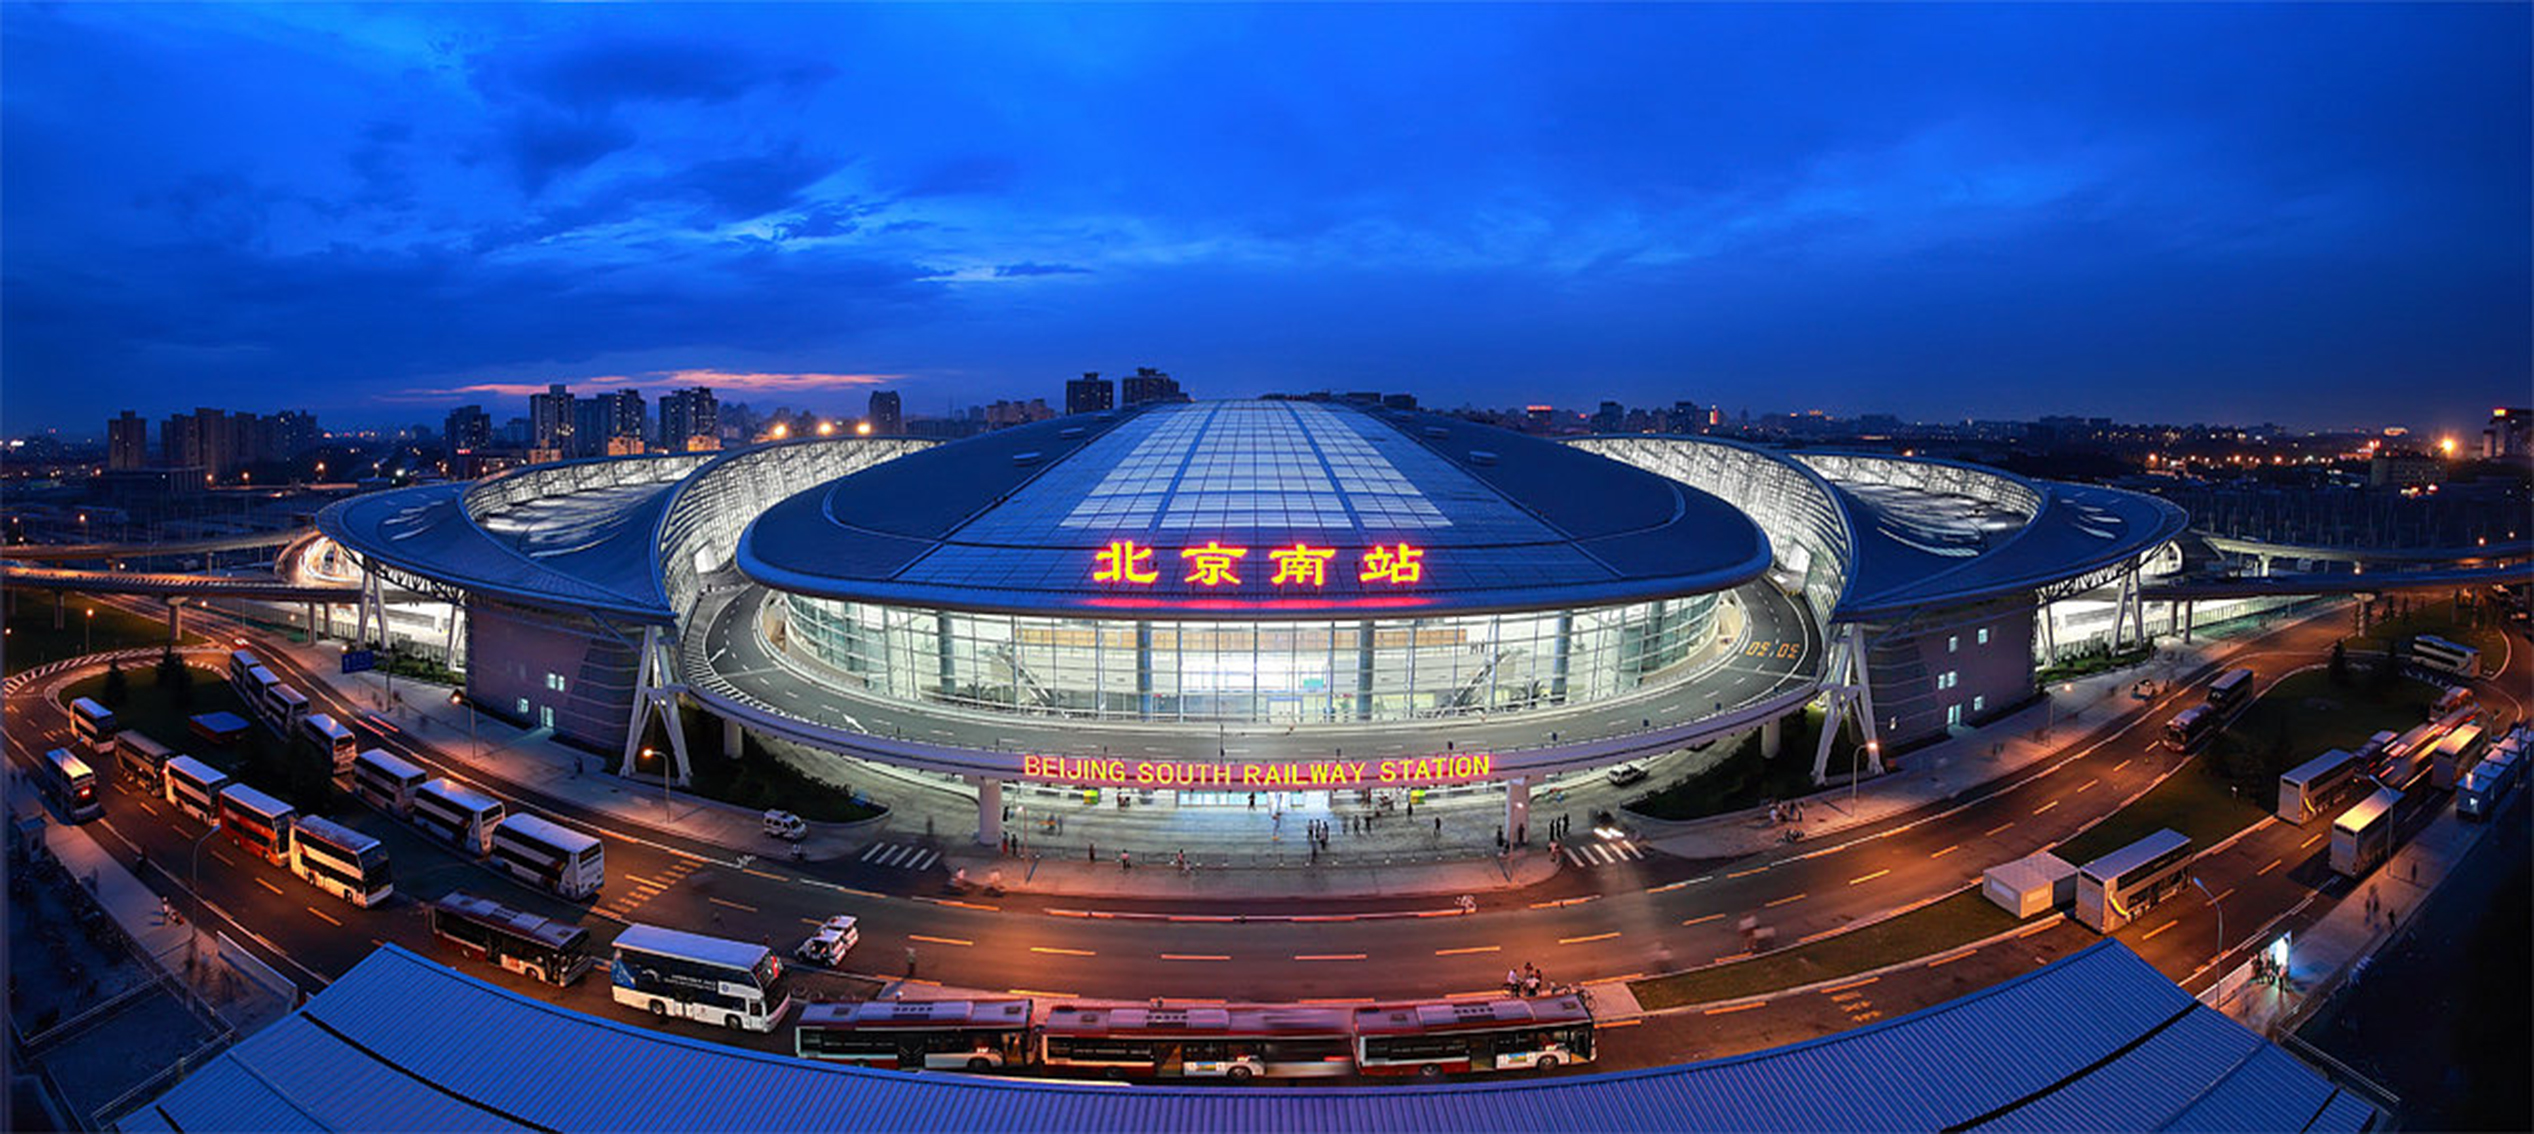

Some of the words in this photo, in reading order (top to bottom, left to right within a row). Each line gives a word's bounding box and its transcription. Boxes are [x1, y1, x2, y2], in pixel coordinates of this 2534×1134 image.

[1094, 541, 1424, 586] 北京南站
[1024, 755, 1126, 782] BEIJING
[1138, 763, 1231, 785] SOUTH
[1244, 762, 1366, 785] RAILWAY
[1380, 755, 1490, 782] STATION
